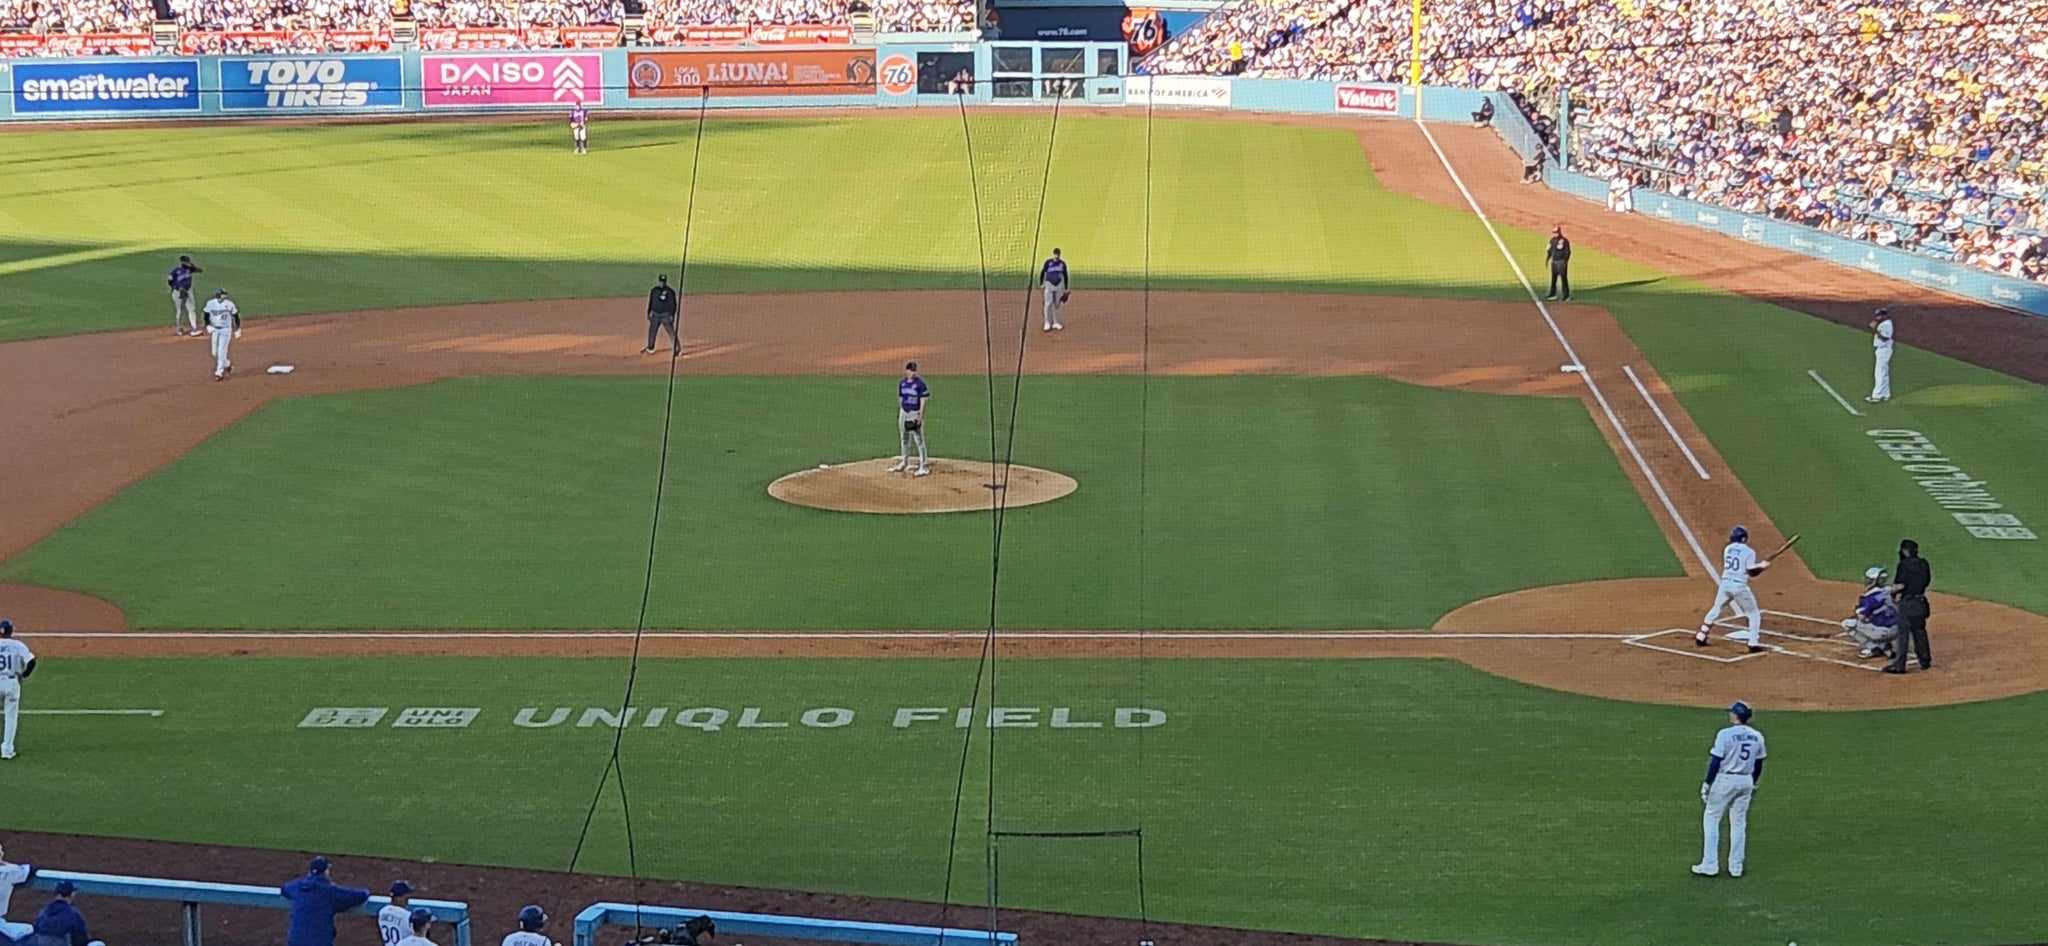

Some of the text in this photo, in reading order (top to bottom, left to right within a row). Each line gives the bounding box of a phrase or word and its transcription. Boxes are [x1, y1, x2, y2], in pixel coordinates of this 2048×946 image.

[1129, 18, 1157, 43] 76
[247, 61, 345, 84] TOYO
[441, 62, 544, 84] DAISO
[675, 74, 701, 85] 300
[706, 62, 788, 84] LiUNA!
[885, 64, 911, 85] 76
[23, 73, 189, 101] smartwater
[264, 82, 369, 107] TIRES
[442, 85, 491, 96] JAPAN
[1128, 88, 1208, 97] BAN OF AMERICA
[1339, 88, 1396, 110] Yakult
[1725, 555, 1740, 571] 50
[410, 709, 464, 717] UNI
[513, 707, 1167, 731] UNIQLO FIELD
[1739, 743, 1751, 760] 5
[381, 924, 400, 945] 30
